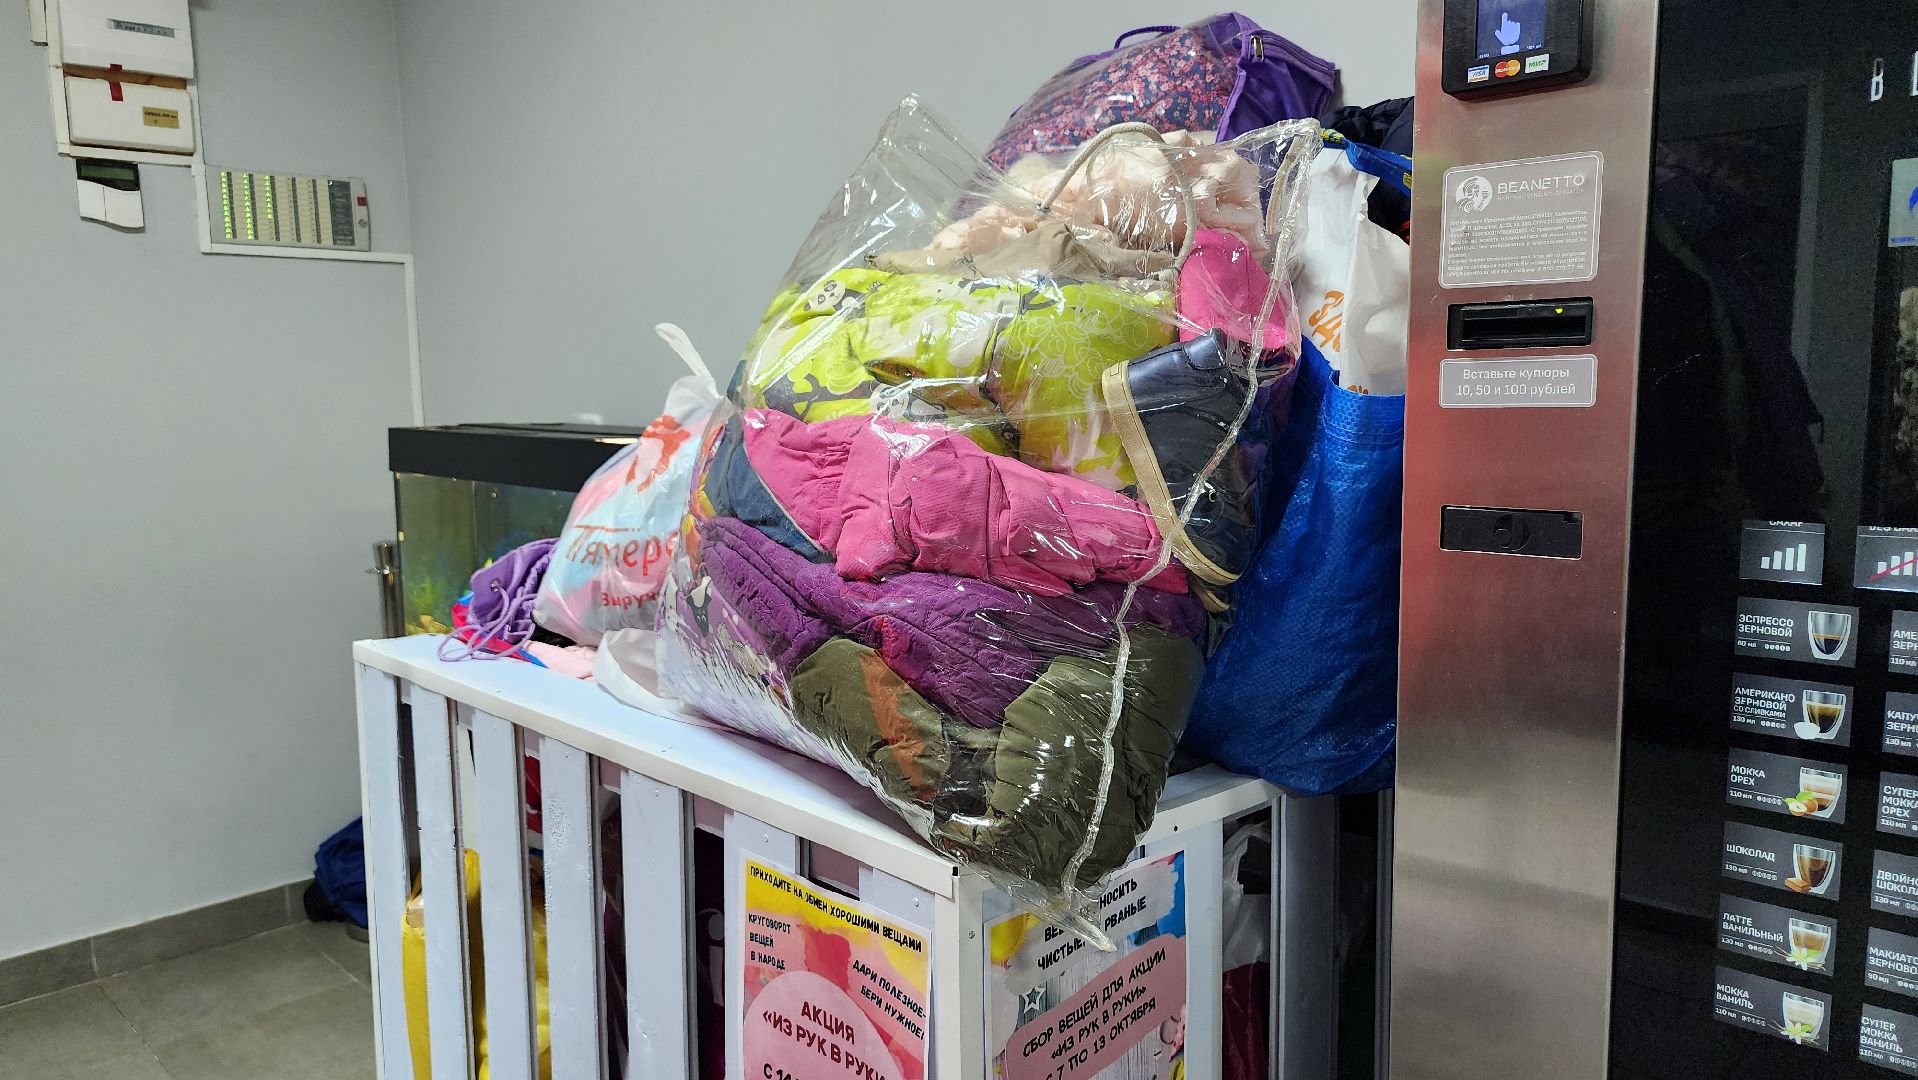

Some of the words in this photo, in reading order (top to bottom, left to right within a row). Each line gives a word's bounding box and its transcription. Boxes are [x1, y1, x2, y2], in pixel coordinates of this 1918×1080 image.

[1497, 174, 1585, 194] BEANETTO
[1463, 369, 1516, 380] Вставьте
[1519, 368, 1570, 380] купюры
[1476, 384, 1491, 396] 50
[1494, 386, 1501, 395] и
[1503, 384, 1527, 395] 100
[1530, 383, 1576, 397] рублей
[1738, 614, 1794, 627] ЭСПРЕССО
[1738, 624, 1793, 637] ЗЕРНОВОЙ
[1893, 630, 1918, 640] АМЕ
[1734, 687, 1796, 703] АМЕРИКАНО
[1734, 697, 1787, 711] ЗЕРНОВОЙ
[1744, 706, 1786, 718] СЛИВКАМИ
[1732, 716, 1746, 724] 130
[1888, 710, 1918, 721] КАПУ
[1731, 764, 1766, 778] МОККА
[1730, 774, 1755, 786] ОРЕХ
[1882, 806, 1910, 818] ОРЕХ
[1726, 843, 1776, 862] ШОКОЛАД
[750, 866, 792, 893] ПРИХОДИТЕ
[793, 886, 804, 900] НА
[805, 892, 828, 913] ОБМЕН
[830, 905, 880, 934] ХОРОШИМИ
[882, 926, 922, 952] ВЕЩАМИ
[1104, 896, 1147, 933] РВАНЫЕ
[748, 913, 791, 935] КРУГОВОРОТ
[1722, 912, 1753, 927] ЛАТТЕ
[749, 932, 774, 948] ВЕЩЕЙ
[1722, 922, 1784, 943] ВАНИЛЬНЫЙ
[750, 951, 756, 961] В
[758, 953, 786, 971] НАРОДЕ
[1868, 956, 1918, 975] ЗЕРНОВО
[852, 960, 878, 983] ДАРИ
[860, 984, 883, 1008] БЕРИ
[1716, 983, 1750, 999] МОККА
[1022, 1026, 1054, 1058] СБОР
[1058, 992, 1099, 1034] ВЕЩЕЙ
[1102, 976, 1124, 1006] ДЛЯ
[1128, 948, 1166, 983] АКЦИИ
[1716, 992, 1754, 1010] ВАНИЛЬ
[800, 1000, 855, 1045] АКЦИЯ
[1050, 1035, 1075, 1060] «ИЗ
[1078, 1018, 1100, 1043] РУК
[1102, 1009, 1110, 1025] В
[1112, 986, 1147, 1016] РУКИ»
[1861, 1016, 1896, 1032] СУПЕР
[762, 1010, 793, 1037] «ИЗ
[796, 1024, 828, 1057] РУК
[830, 1042, 842, 1064] В
[1056, 1064, 1065, 1080] 7
[1068, 1048, 1088, 1072] ПО
[1093, 1035, 1106, 1054] 13
[1109, 996, 1156, 1041] ОКТЯБРЯ
[1860, 1026, 1898, 1042] МОККА
[1860, 1035, 1904, 1054] ВАНИЛЬ
[763, 1062, 773, 1080] С
